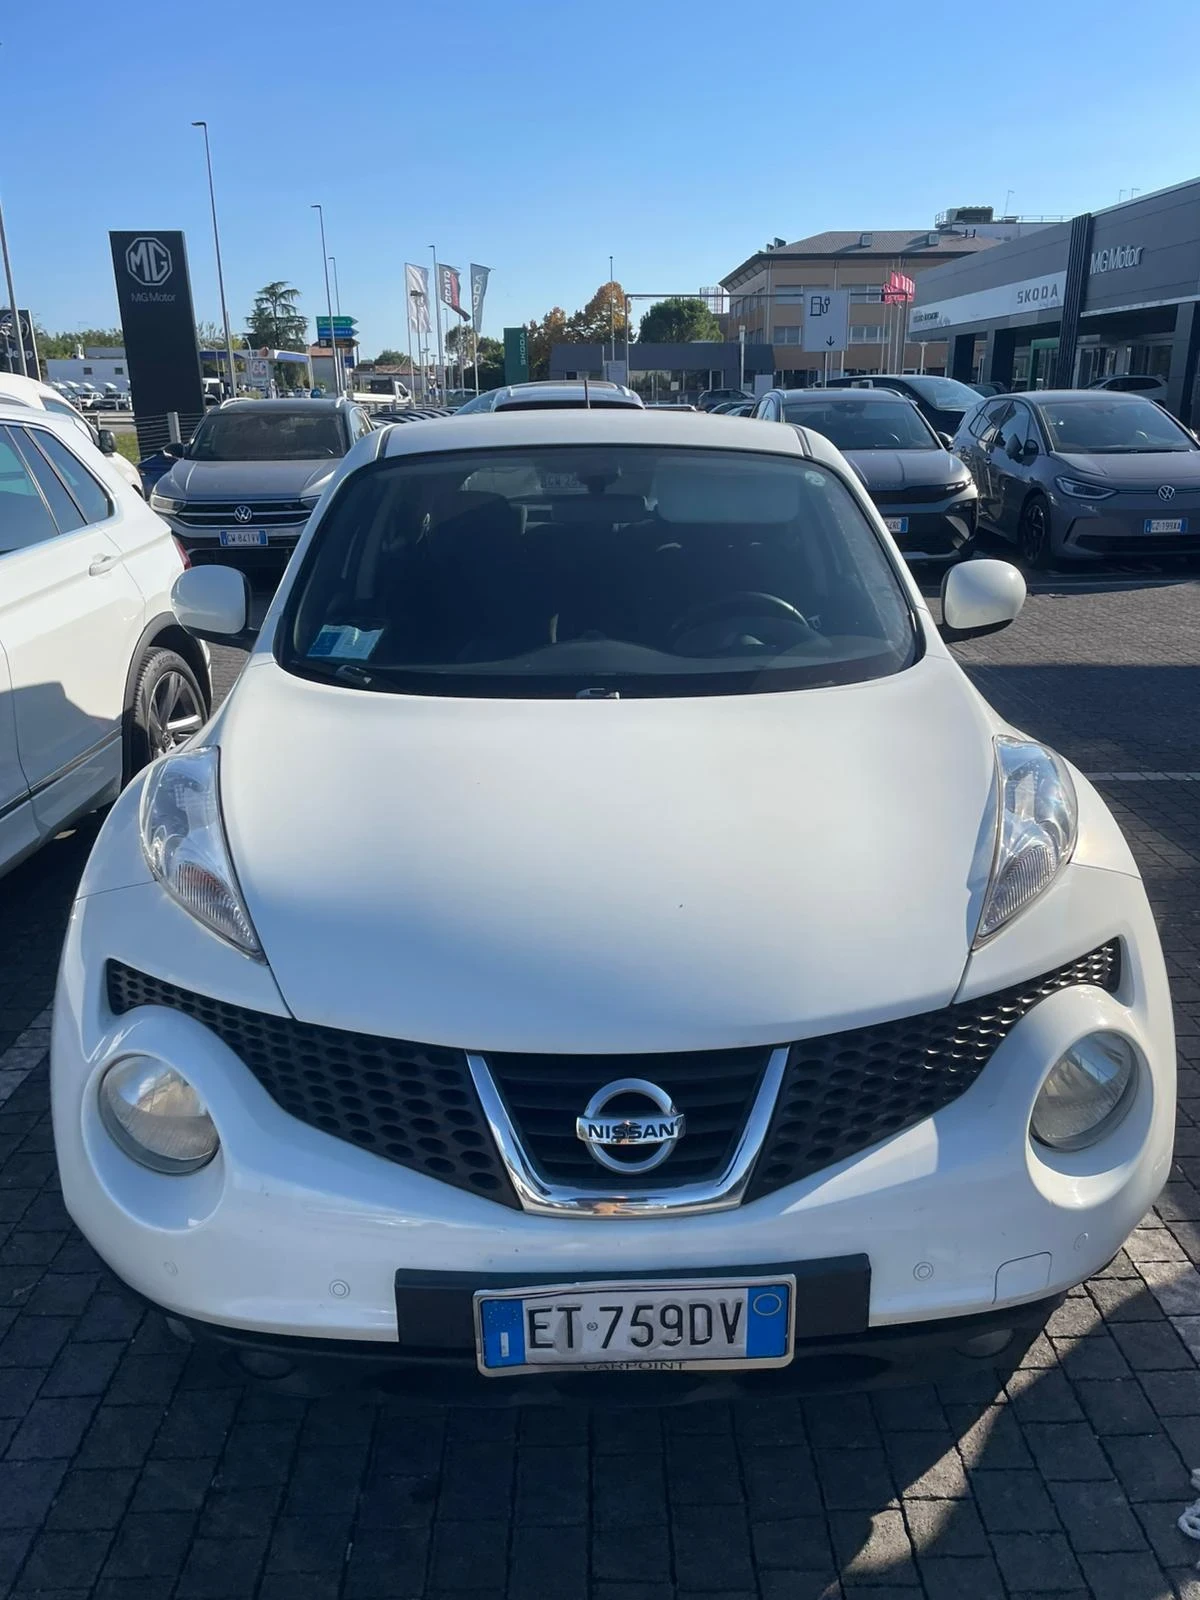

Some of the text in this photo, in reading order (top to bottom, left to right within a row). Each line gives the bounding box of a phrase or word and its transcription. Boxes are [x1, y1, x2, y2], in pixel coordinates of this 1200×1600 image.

[130, 242, 168, 281] MG
[1017, 284, 1058, 304] SKODA
[5, 347, 34, 361] Jep
[588, 1122, 675, 1139] NISSAN
[527, 1305, 582, 1350] ET
[599, 1302, 743, 1350] 759DV
[583, 1361, 688, 1371] CARPOINT
